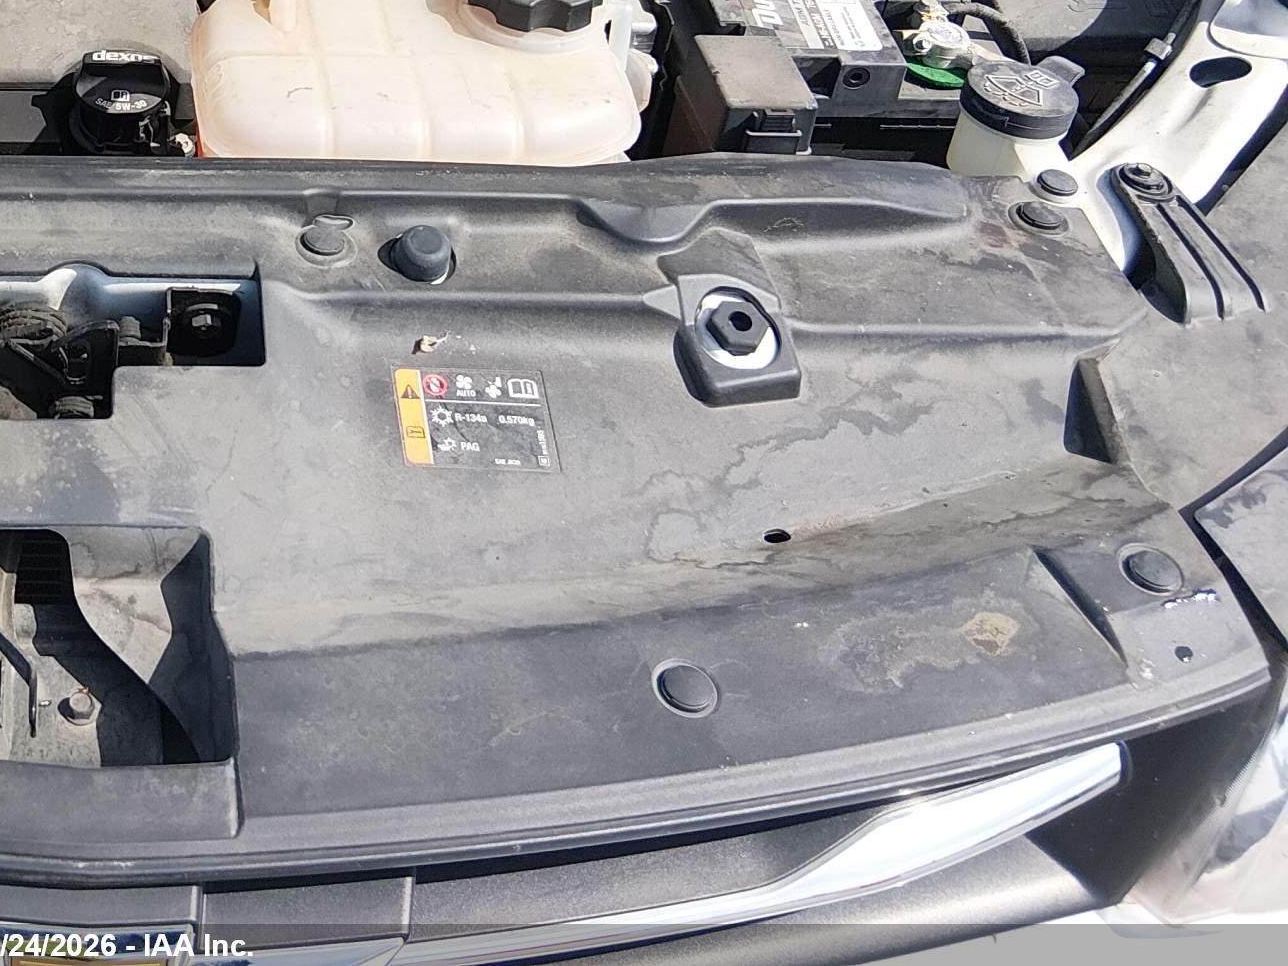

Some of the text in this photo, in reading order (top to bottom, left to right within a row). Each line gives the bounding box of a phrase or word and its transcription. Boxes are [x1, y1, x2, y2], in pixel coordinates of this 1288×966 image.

[92, 50, 158, 63] dexos
[456, 389, 477, 398] AUTO
[454, 412, 536, 426] R-134a 0.570kg
[460, 441, 481, 452] PAG
